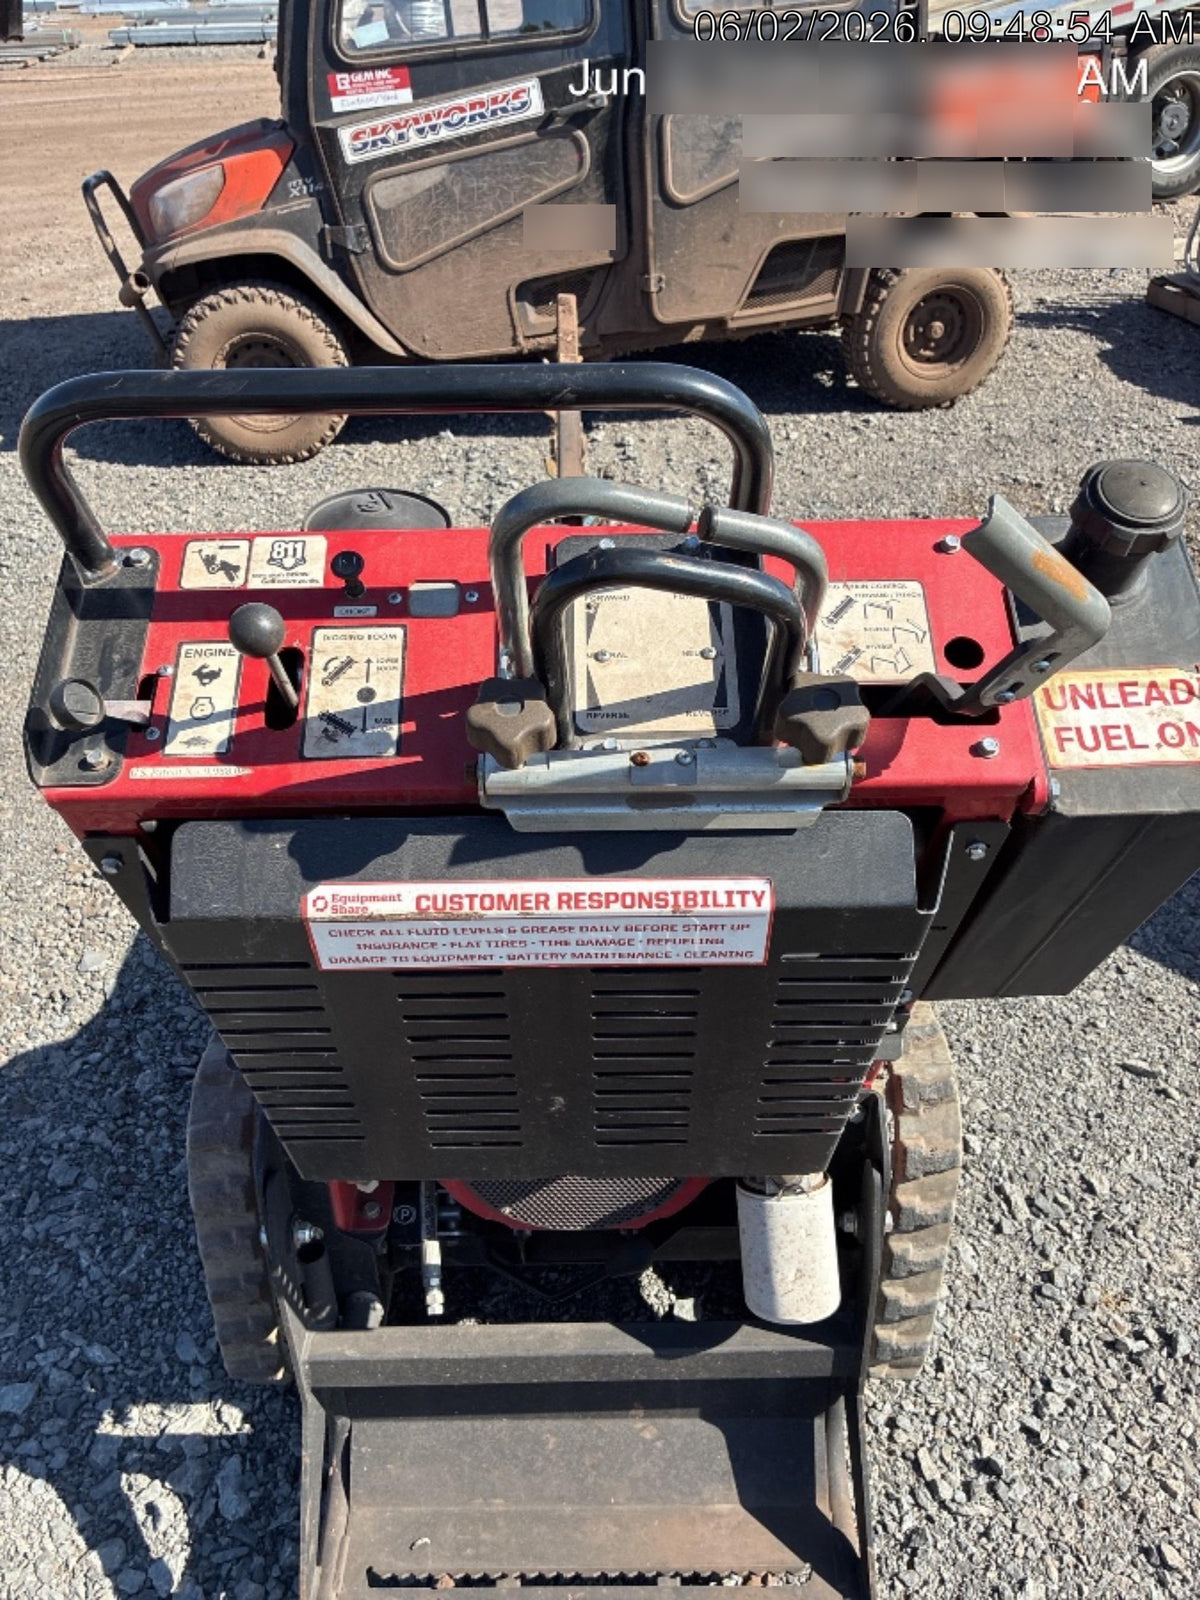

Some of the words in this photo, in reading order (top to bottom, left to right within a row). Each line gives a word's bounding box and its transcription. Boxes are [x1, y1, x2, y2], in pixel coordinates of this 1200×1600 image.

[350, 87, 532, 154] SKYWORKS
[271, 540, 306, 559] 811
[184, 648, 236, 659] ENGINE
[1054, 724, 1149, 752] FUEL
[331, 893, 402, 905] Equipment
[415, 892, 550, 912] CUSTOMER
[557, 890, 766, 910] RESPONSIBILITY
[331, 905, 369, 914] Share
[328, 929, 375, 938] CHECK
[407, 928, 449, 936] FLUID
[453, 927, 504, 935] LEVELS
[521, 926, 575, 934] GREASE
[579, 925, 620, 933] DAILY
[624, 924, 678, 932] BEFORE
[682, 924, 727, 932] START
[356, 942, 438, 950] INSURANCE
[450, 941, 481, 949] FLAT
[486, 940, 527, 948] TIRES
[328, 956, 387, 964] DAMAGE
[391, 955, 410, 963] TO
[413, 954, 494, 963] EQUIPMENT
[507, 952, 567, 962] BATTERY
[570, 951, 672, 960] MAINTENANCE
[684, 950, 754, 959] CLEANING
